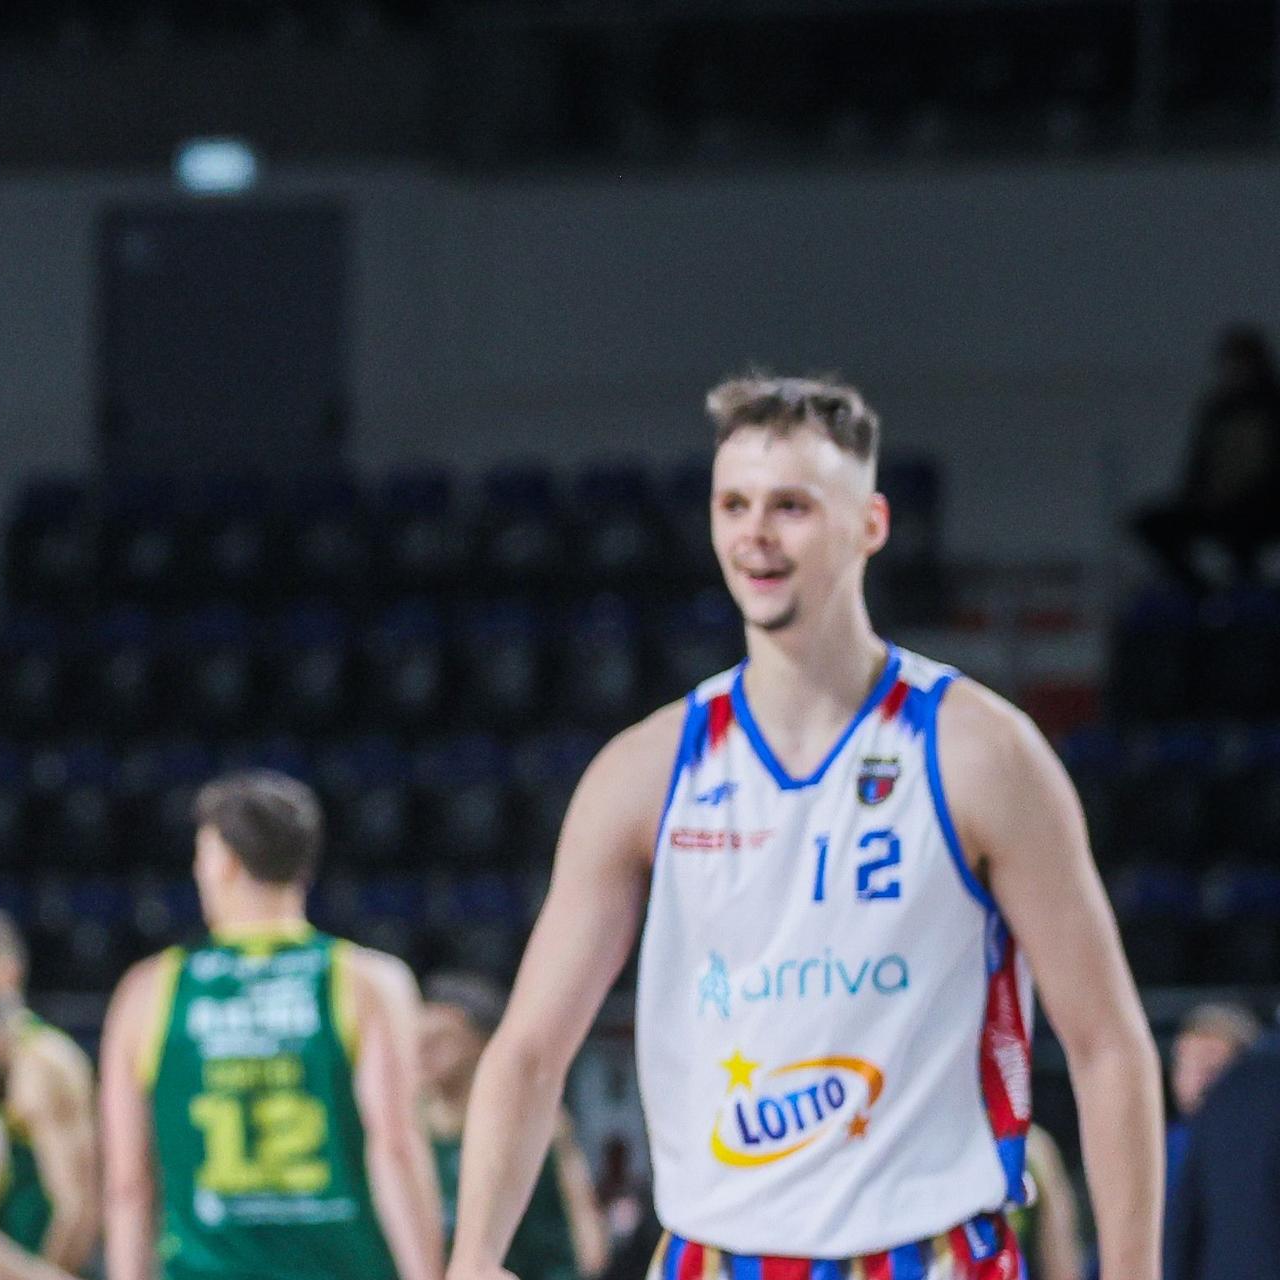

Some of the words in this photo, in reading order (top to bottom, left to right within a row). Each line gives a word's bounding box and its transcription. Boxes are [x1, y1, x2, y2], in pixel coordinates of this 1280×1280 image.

[814, 829, 901, 902] 12
[742, 949, 909, 1001] arriva
[189, 1094, 329, 1193] 12
[736, 1076, 845, 1145] LOTTO
